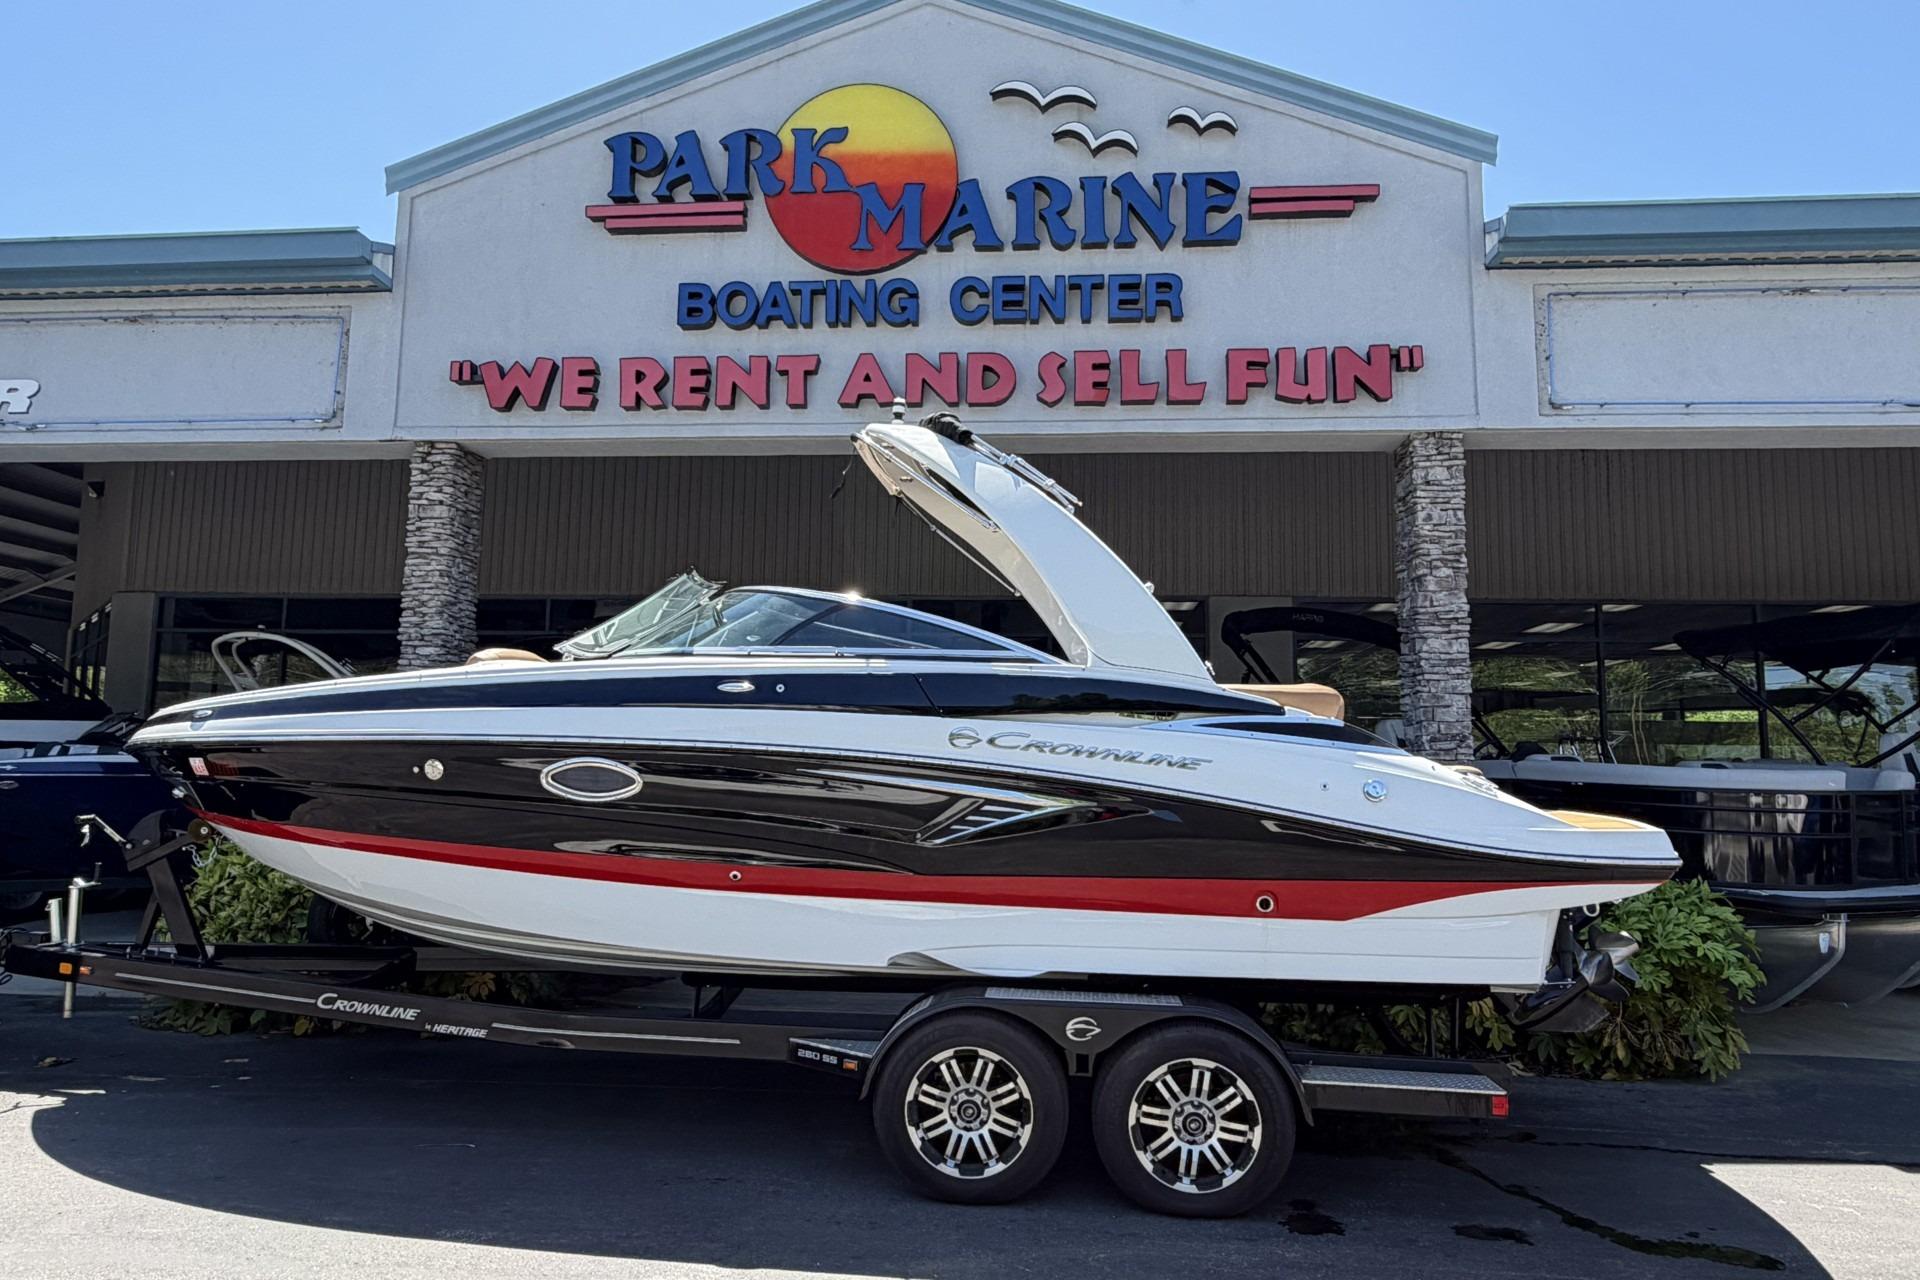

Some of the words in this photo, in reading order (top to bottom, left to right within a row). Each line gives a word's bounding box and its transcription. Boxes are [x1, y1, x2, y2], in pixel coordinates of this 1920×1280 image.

[604, 126, 851, 203] PARK
[850, 171, 1243, 252] MARINE
[677, 277, 919, 330] BOATING
[949, 272, 1184, 326] CENTER
[450, 357, 600, 412] "WE
[619, 353, 820, 411] RENT
[838, 351, 1017, 409] AND
[1036, 348, 1207, 407] SELL
[1225, 343, 1424, 405] FUN"
[986, 731, 1212, 770] CROWNLINE
[316, 992, 421, 1021] CROWNLINE
[432, 1023, 489, 1038] HERITAGE
